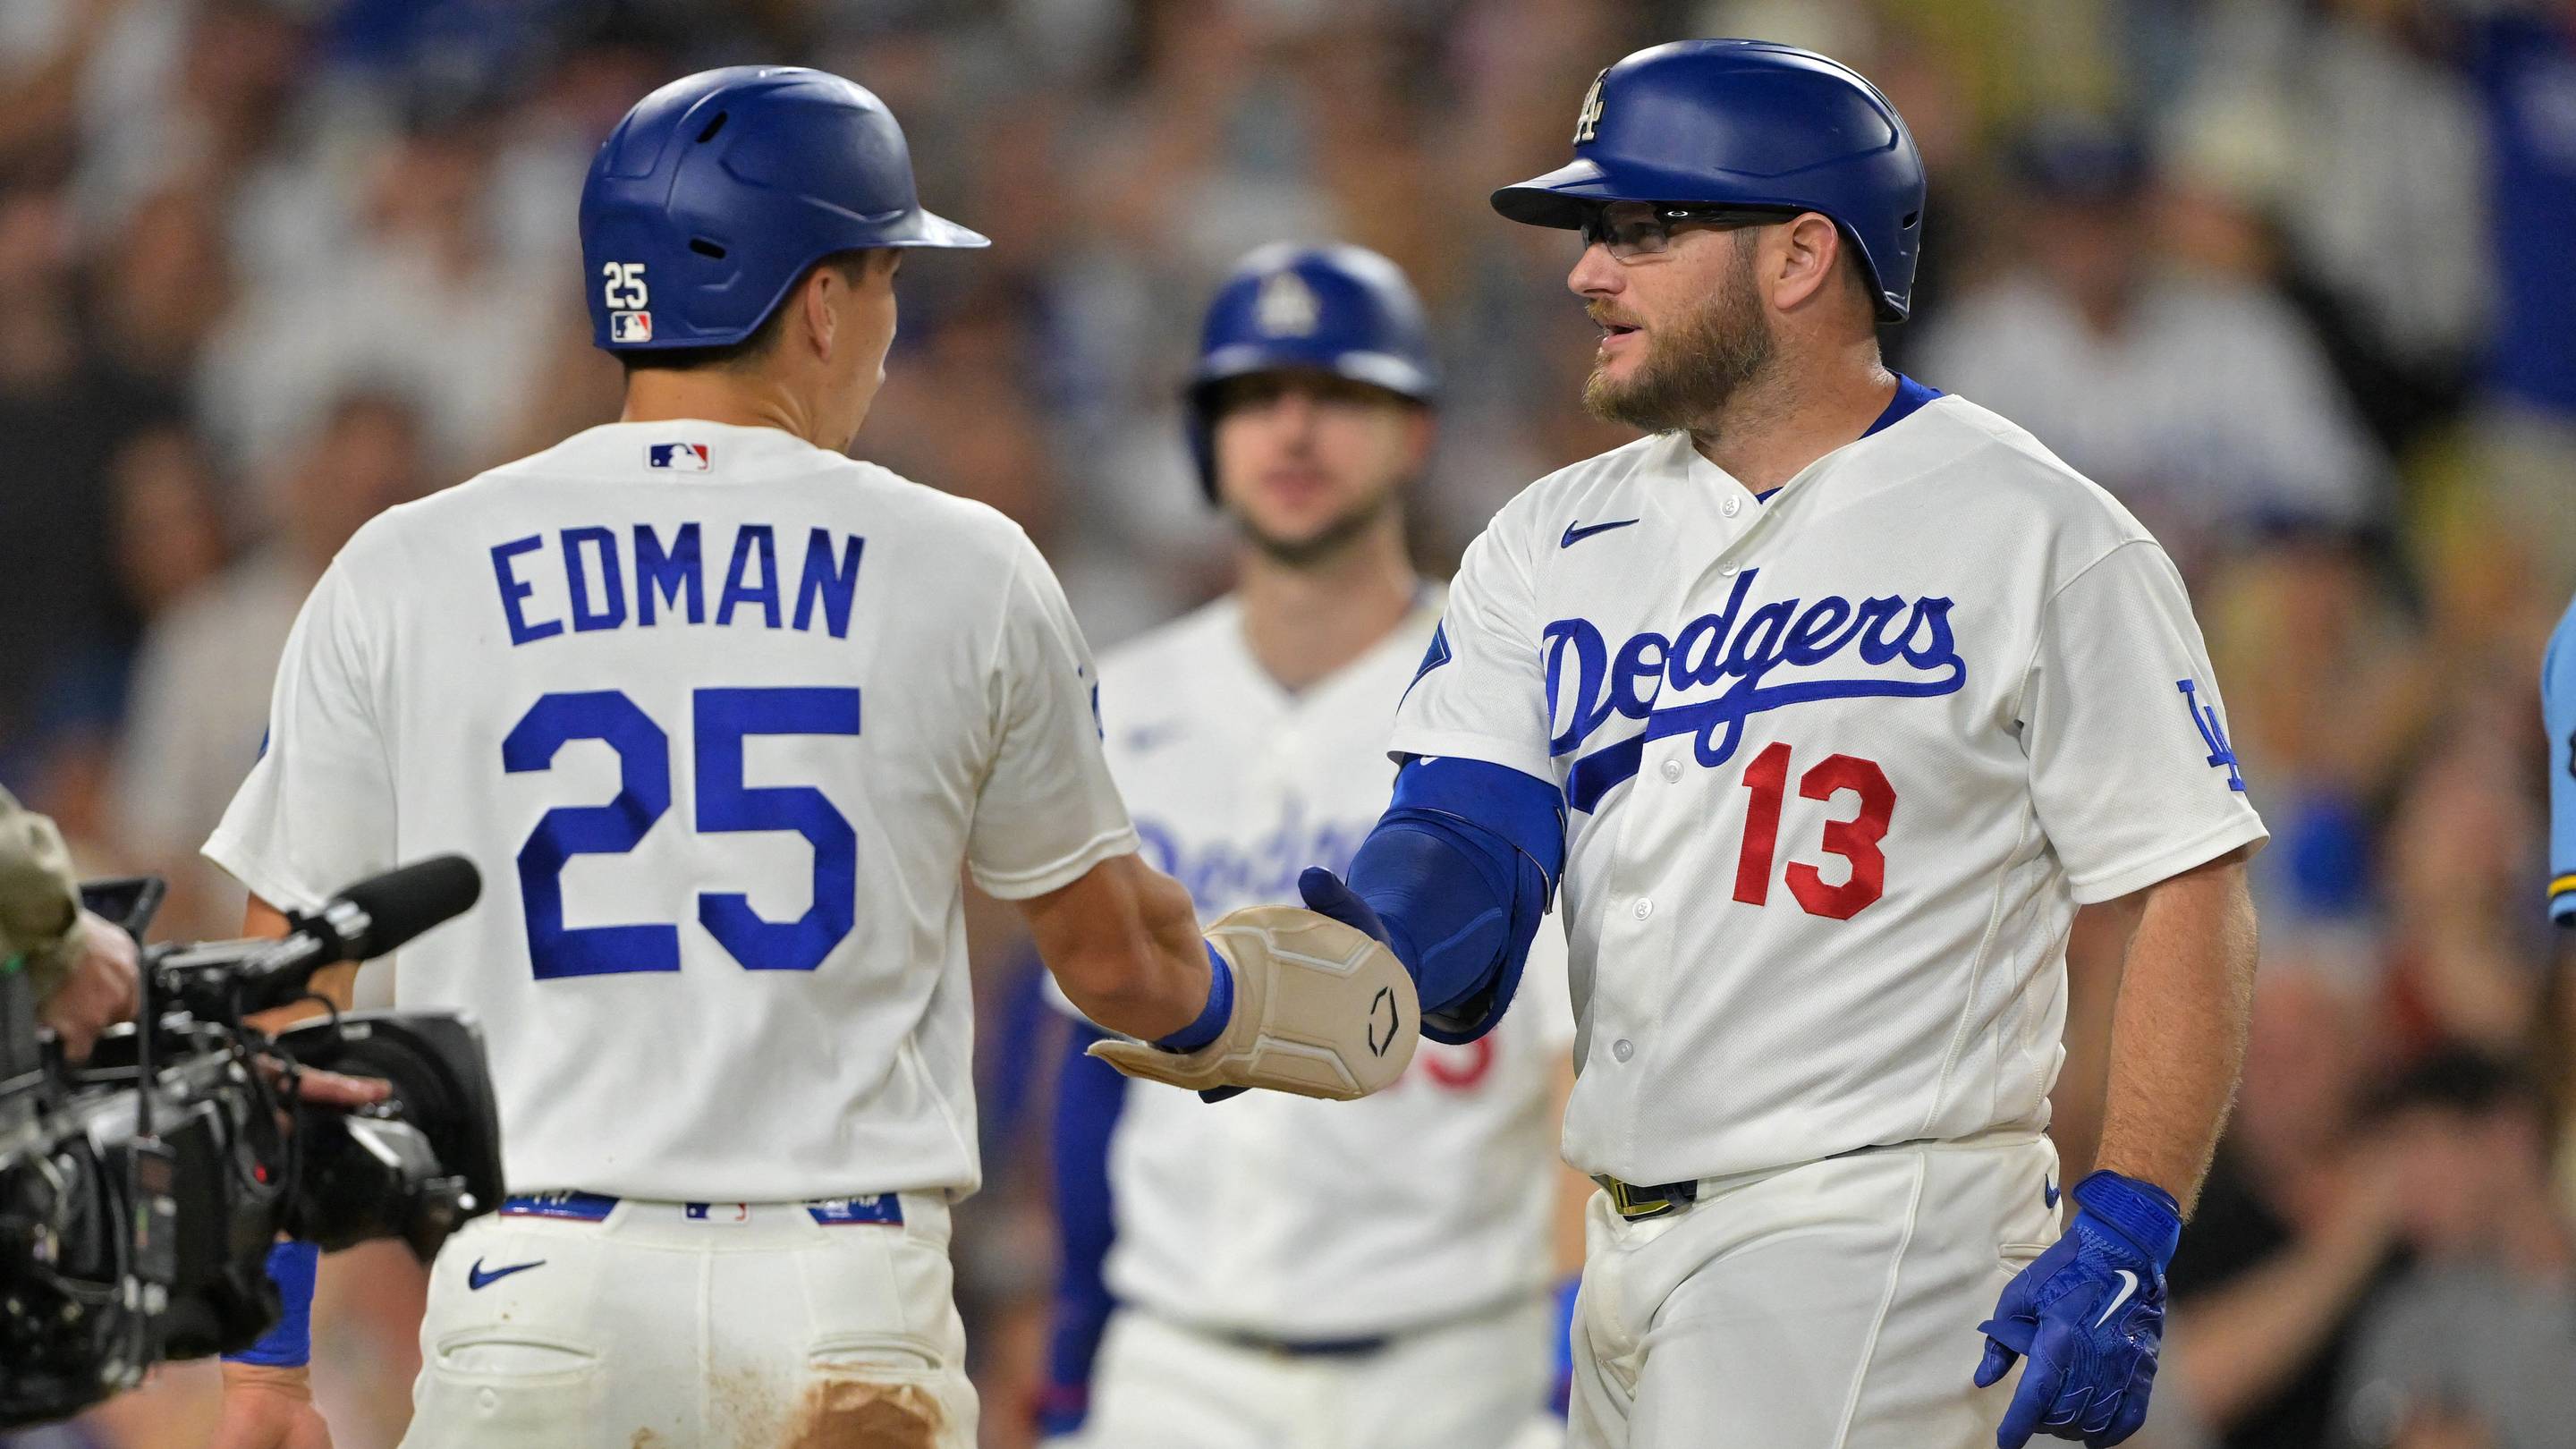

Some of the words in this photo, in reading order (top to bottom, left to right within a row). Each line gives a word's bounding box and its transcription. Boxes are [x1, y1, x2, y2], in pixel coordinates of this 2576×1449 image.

[602, 260, 648, 309] 25
[490, 522, 864, 645] EDMAN
[1540, 568, 1965, 768] Dodgers
[501, 686, 861, 980] 25
[1732, 741, 1897, 919] 13
